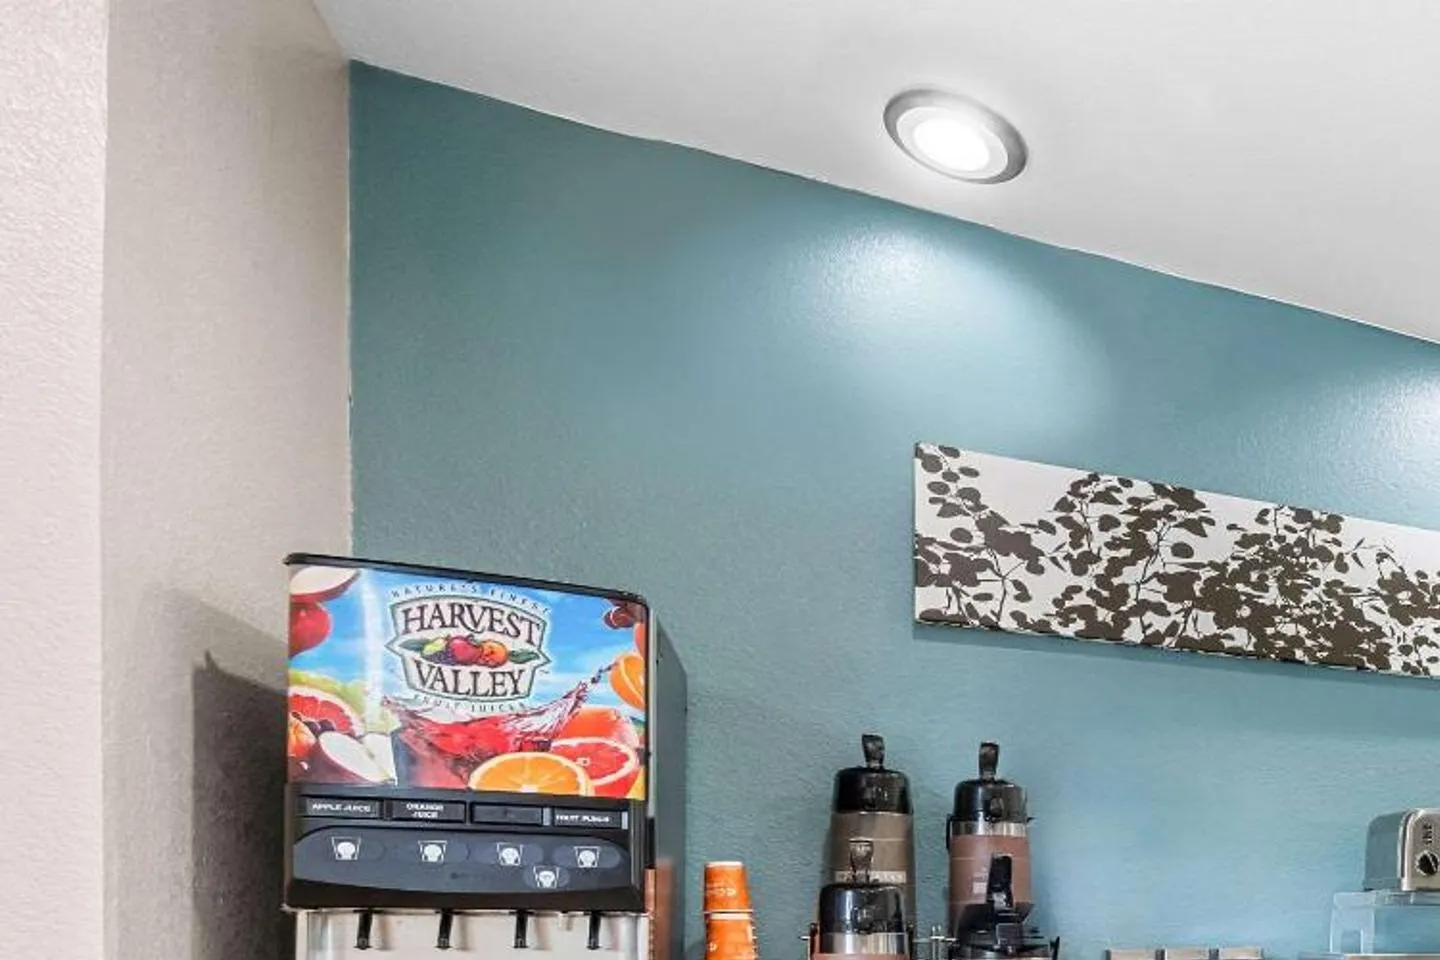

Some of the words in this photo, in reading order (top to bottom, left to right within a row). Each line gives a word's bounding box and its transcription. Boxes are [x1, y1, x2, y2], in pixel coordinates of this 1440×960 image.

[402, 602, 540, 646] HARVEST
[412, 657, 525, 697] VALLEY
[312, 803, 342, 811] APPLE
